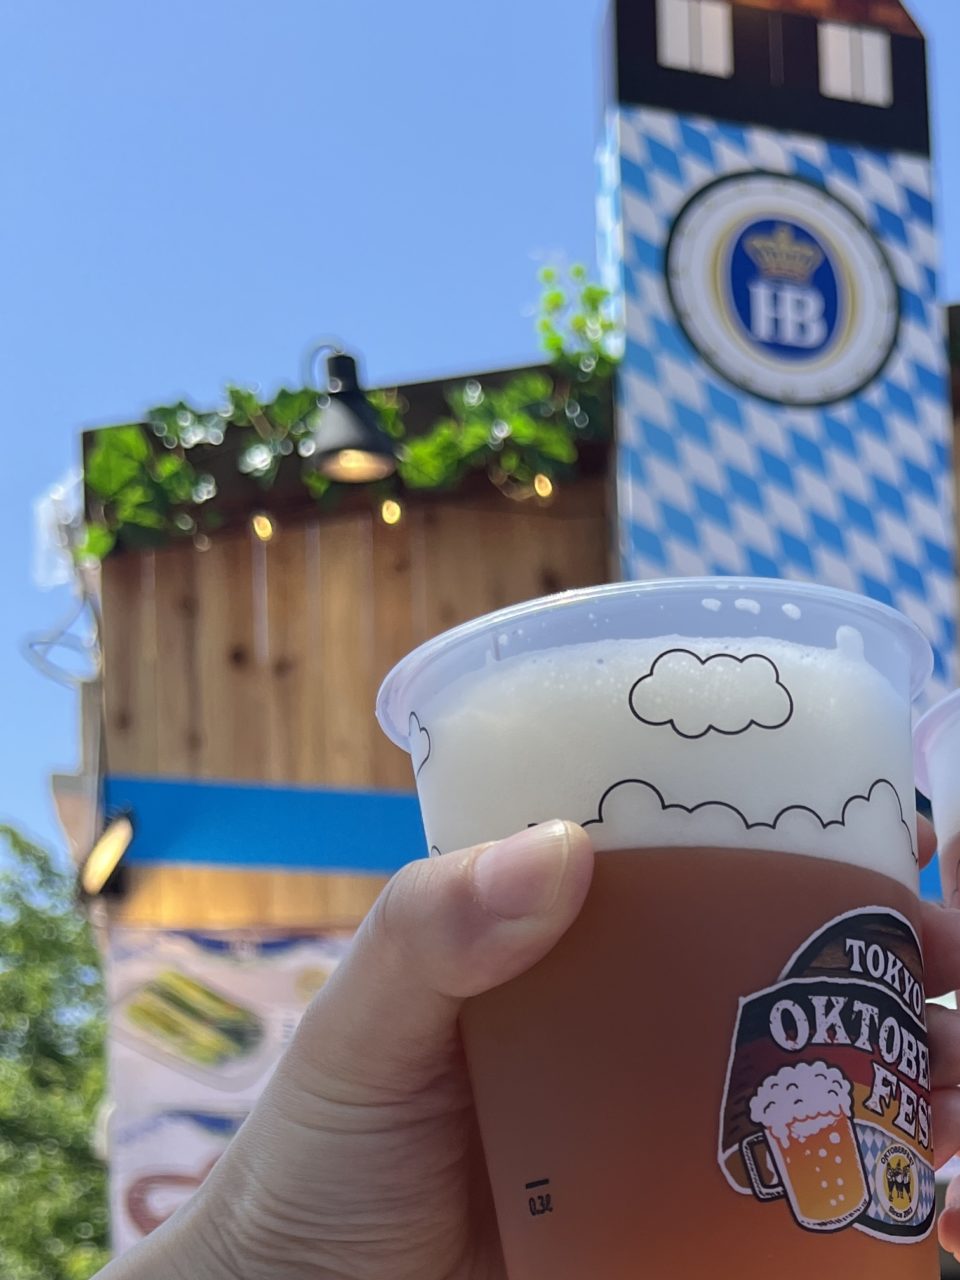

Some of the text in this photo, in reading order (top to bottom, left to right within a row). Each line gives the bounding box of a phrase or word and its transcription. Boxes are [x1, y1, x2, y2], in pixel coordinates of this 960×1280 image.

[748, 280, 828, 349] HB
[845, 937, 922, 1016] TOKYO
[769, 995, 930, 1091] OKTOBE
[865, 1062, 934, 1151] FES
